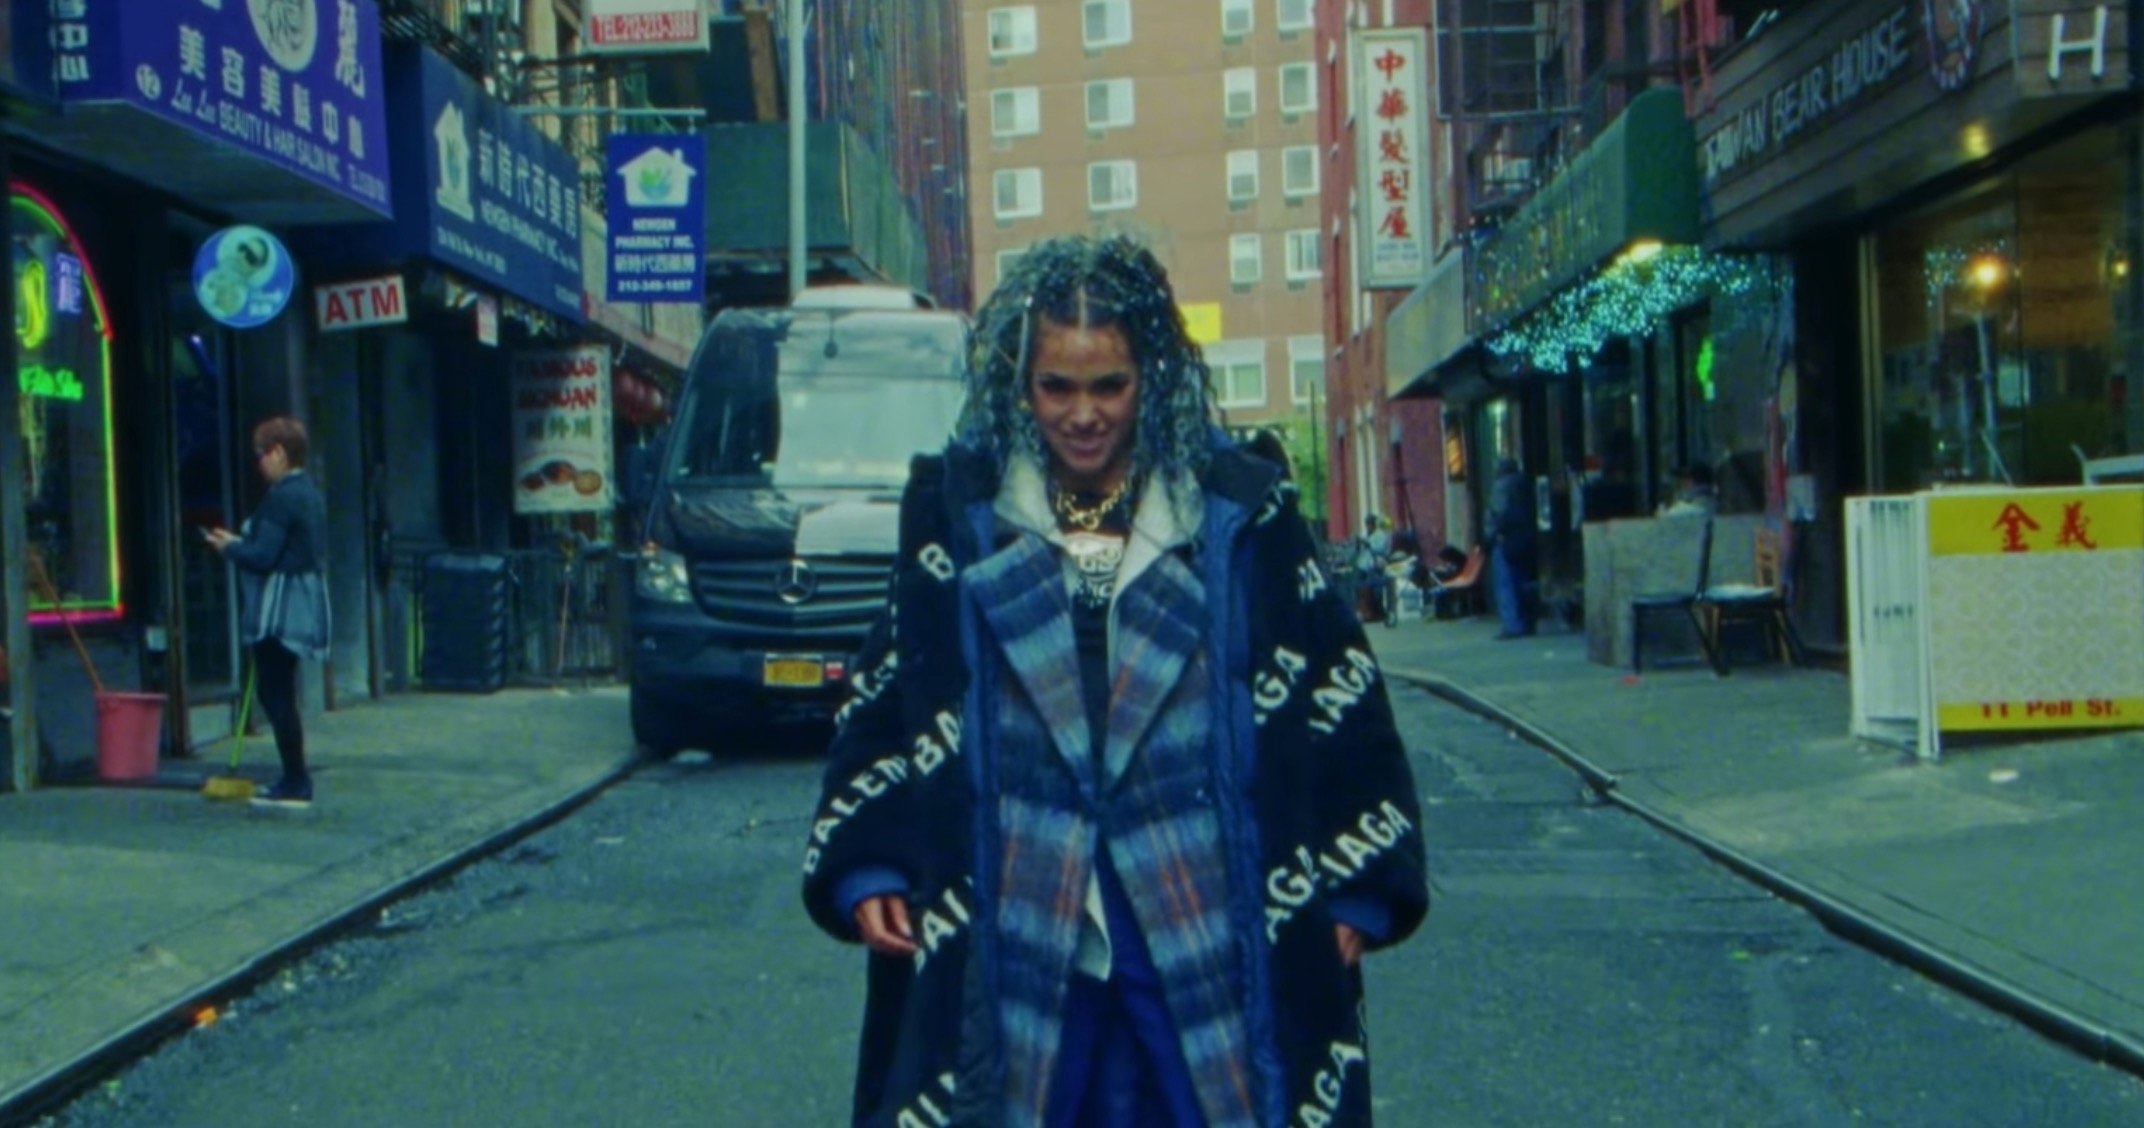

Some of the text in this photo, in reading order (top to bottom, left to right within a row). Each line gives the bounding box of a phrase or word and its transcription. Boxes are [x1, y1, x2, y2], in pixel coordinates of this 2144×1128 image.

[1773, 66, 1828, 143] BEAR
[1832, 8, 1911, 106] HOUSE
[614, 235, 671, 249] PHARMACY
[325, 284, 402, 326] ATM
[2087, 698, 2121, 715] St.
